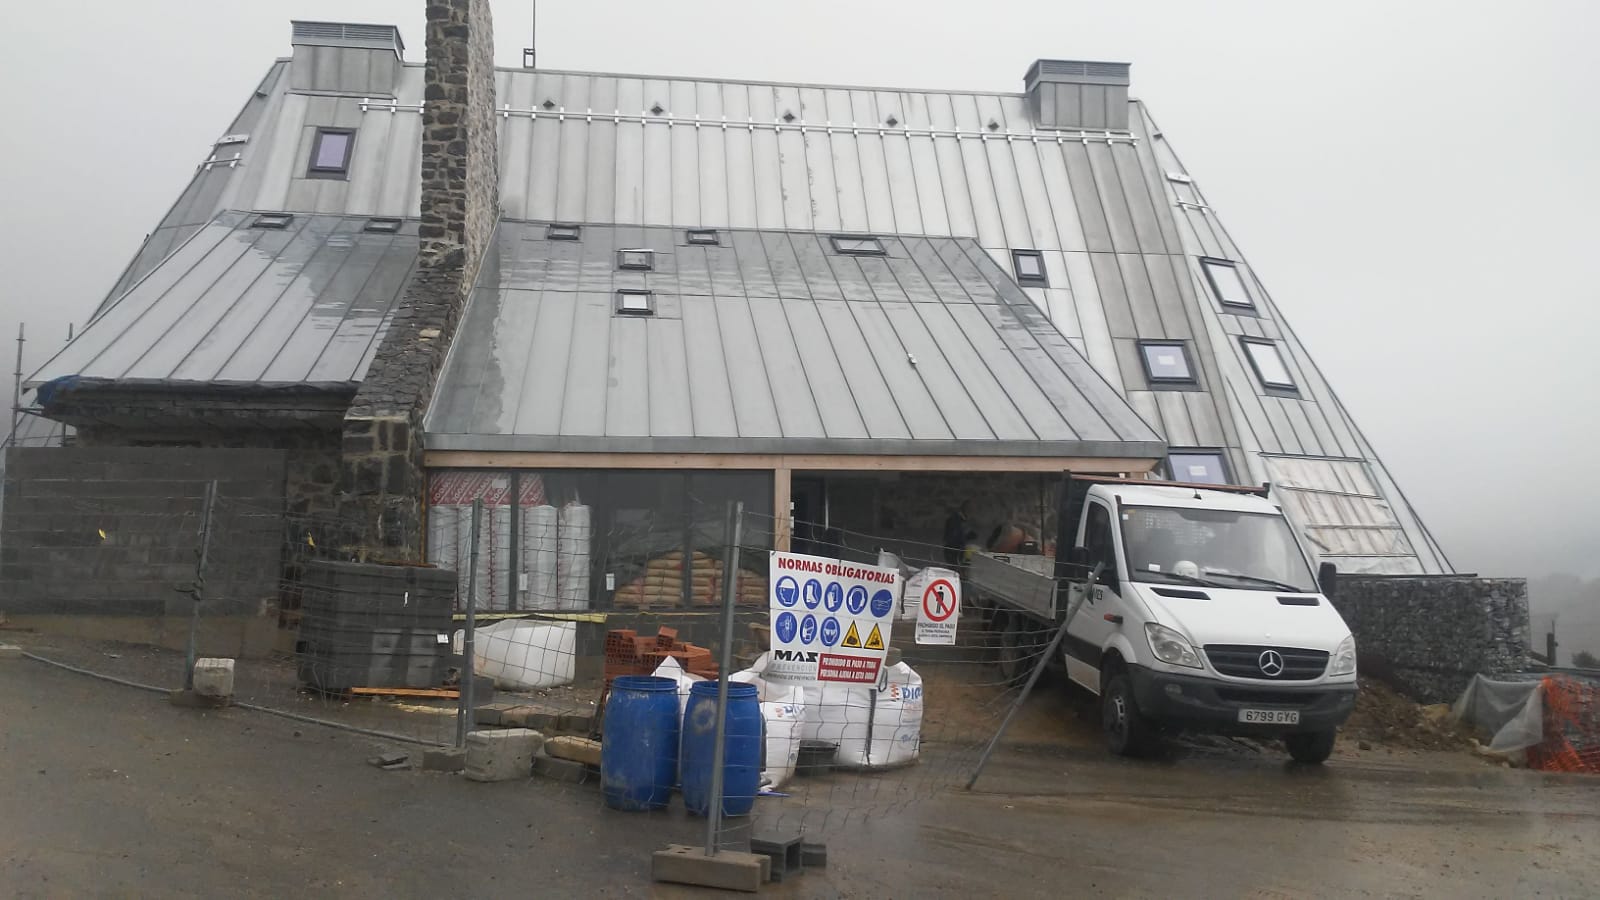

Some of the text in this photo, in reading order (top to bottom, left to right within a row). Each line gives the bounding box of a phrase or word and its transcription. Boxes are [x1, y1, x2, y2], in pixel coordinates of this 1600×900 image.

[778, 558, 895, 584] NORMAS OBLIGATORIAS
[1246, 711, 1297, 722] 6799 GYG
